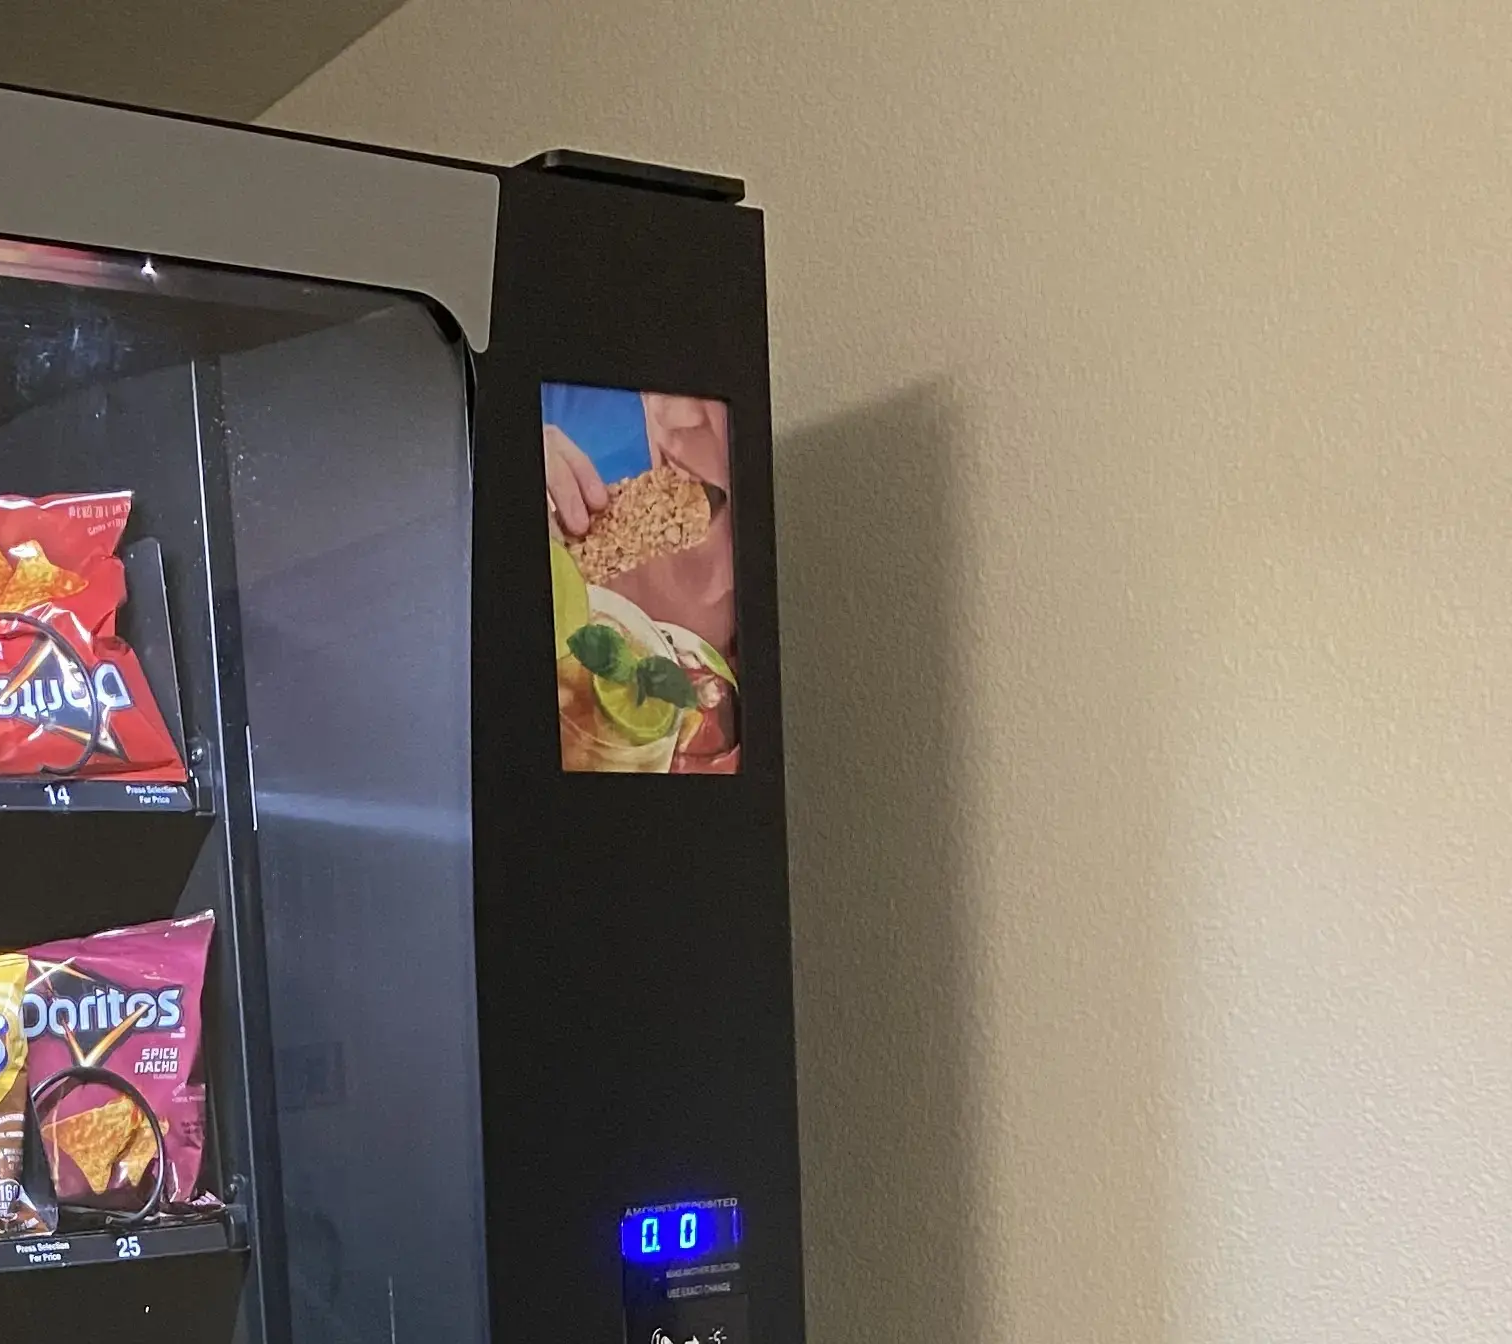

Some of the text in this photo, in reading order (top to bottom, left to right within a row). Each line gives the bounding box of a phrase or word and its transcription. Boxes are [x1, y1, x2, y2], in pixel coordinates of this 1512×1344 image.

[44, 785, 71, 806] 14
[23, 987, 183, 1038] Doritos
[141, 1047, 179, 1061] SPICY
[134, 1060, 179, 1074] NACHO
[116, 1237, 141, 1258] 25
[42, 1251, 61, 1262] Price
